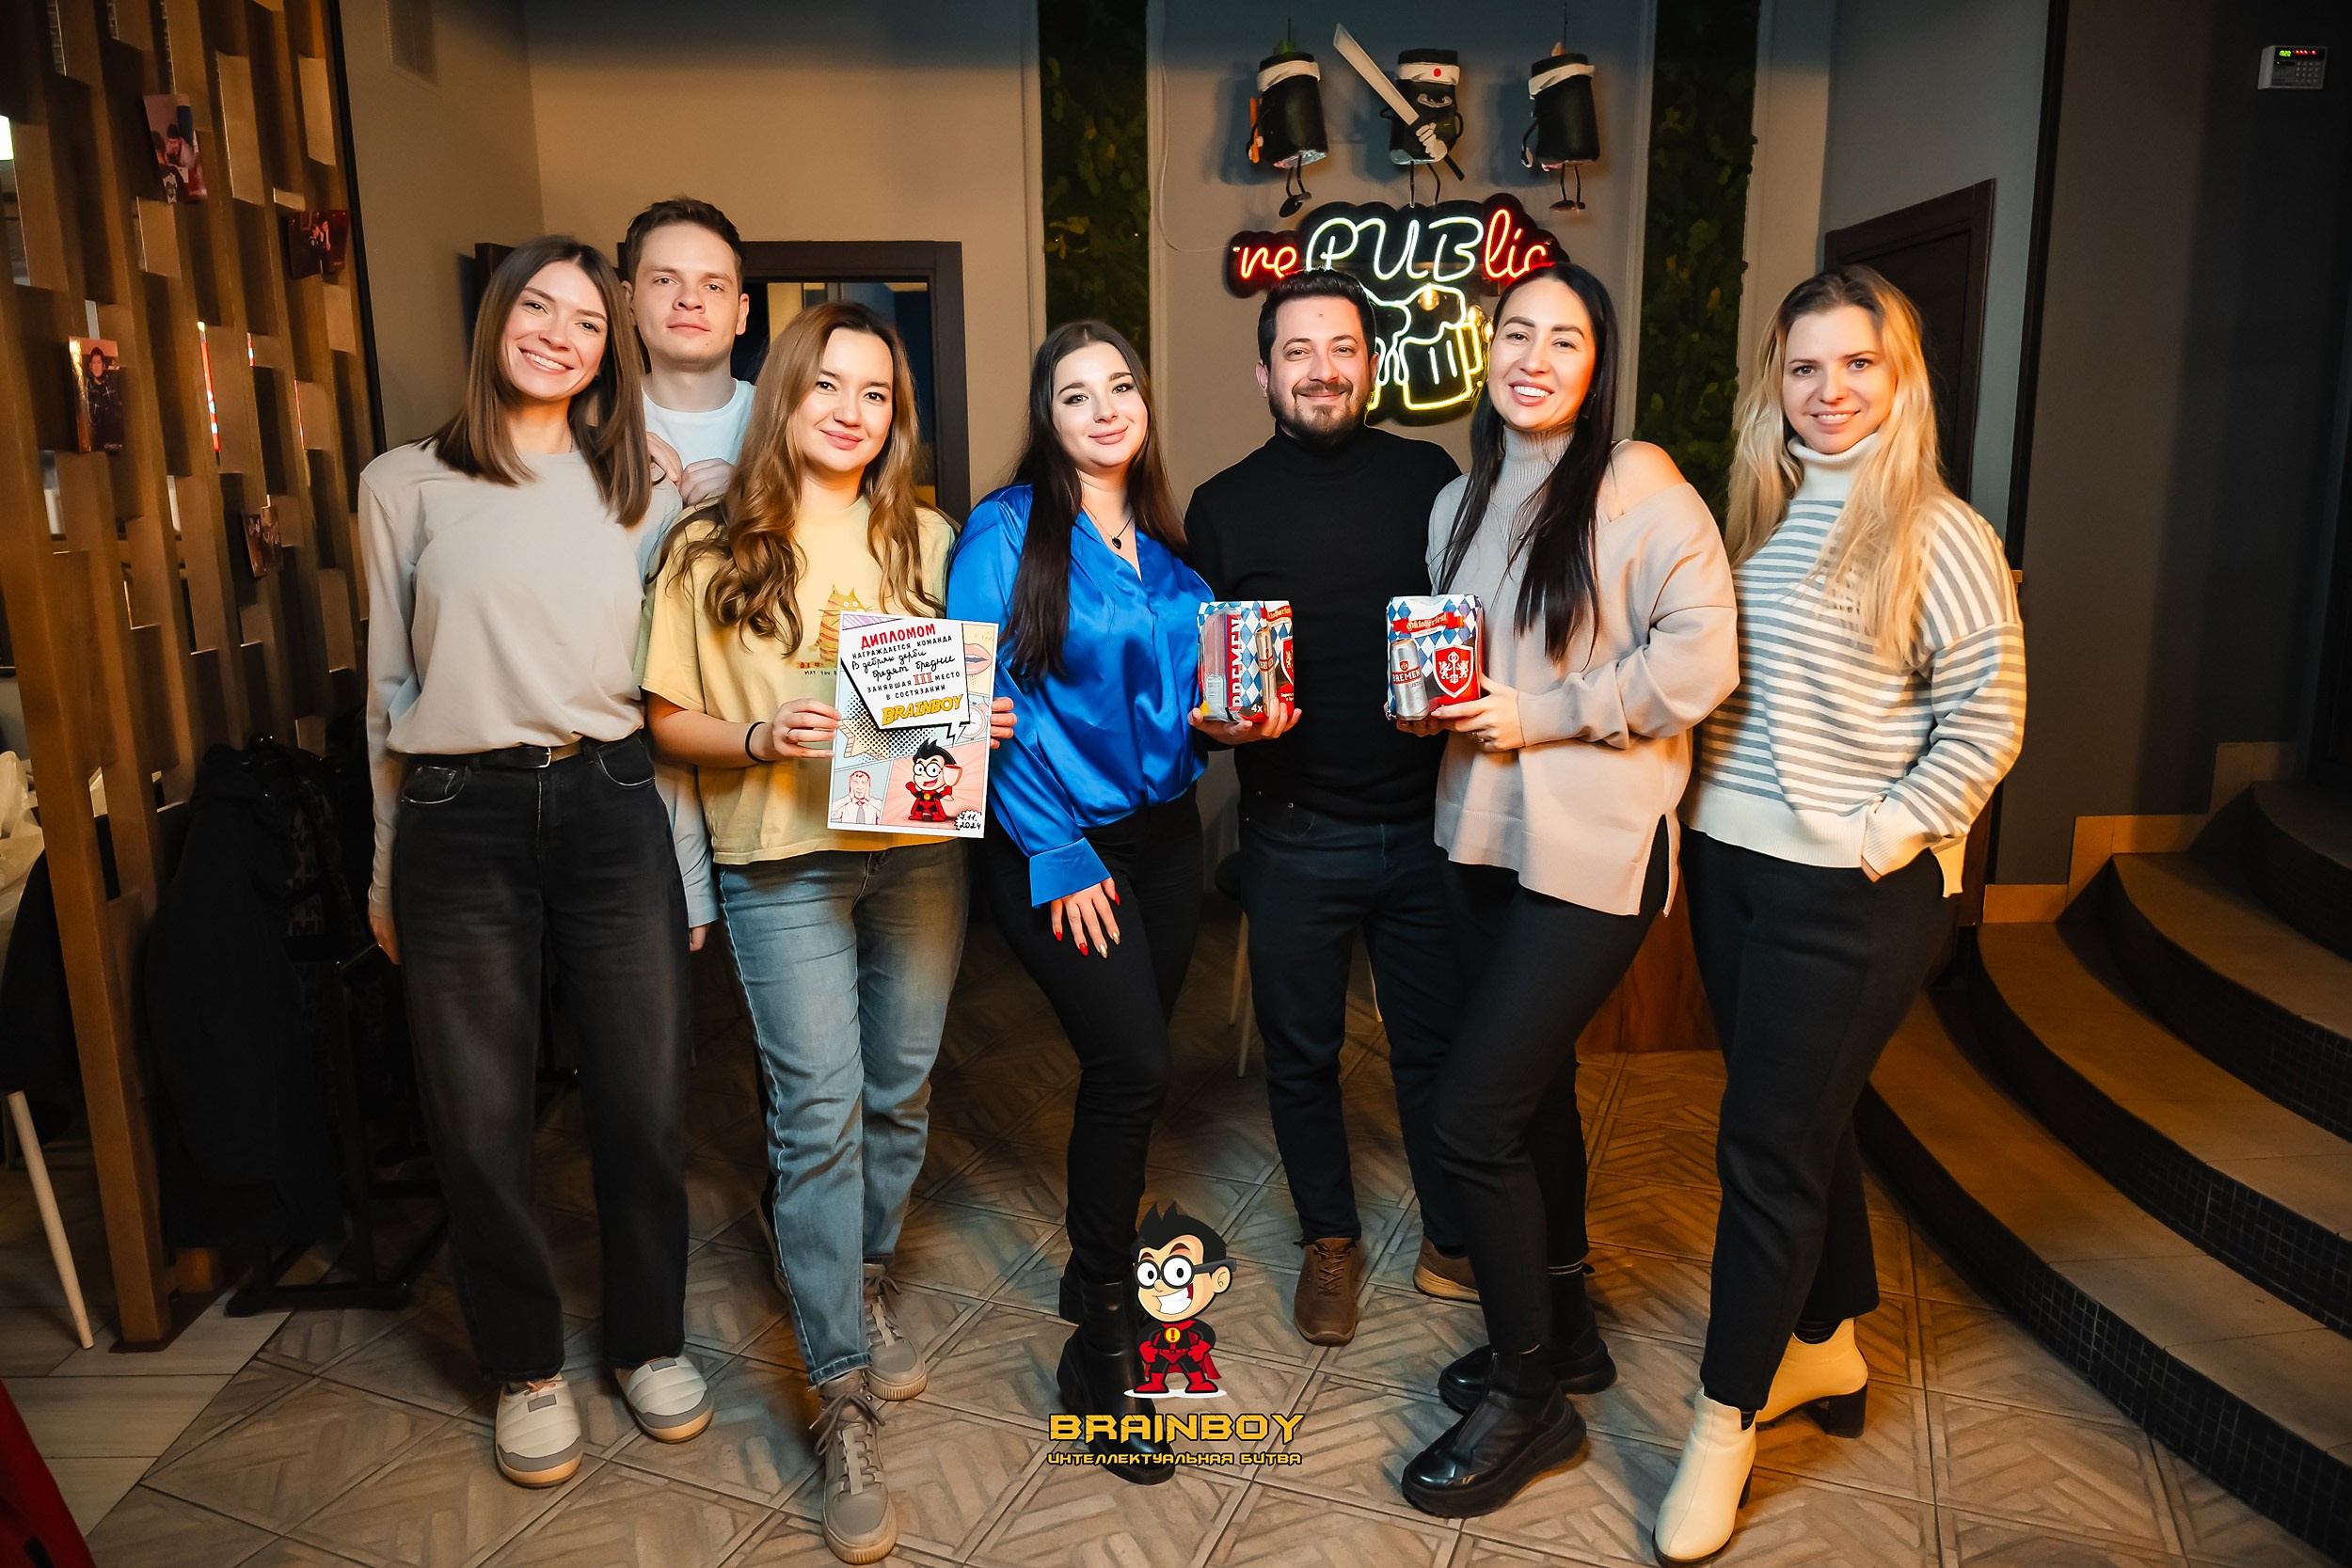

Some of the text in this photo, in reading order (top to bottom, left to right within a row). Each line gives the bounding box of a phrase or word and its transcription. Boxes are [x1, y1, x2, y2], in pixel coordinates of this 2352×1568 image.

[852, 635, 953, 659] НАГРАЖДАЕТСЯ КОМАНДА
[861, 624, 936, 650] ДИПЛОМОМ
[898, 649, 927, 665] дерби
[867, 671, 961, 693] ЗАНЯВШАЯ III МЕСТО
[895, 685, 946, 699] СОСТЯЗАНИИ
[882, 694, 963, 726] BRAINBOY
[960, 821, 981, 830] 2024
